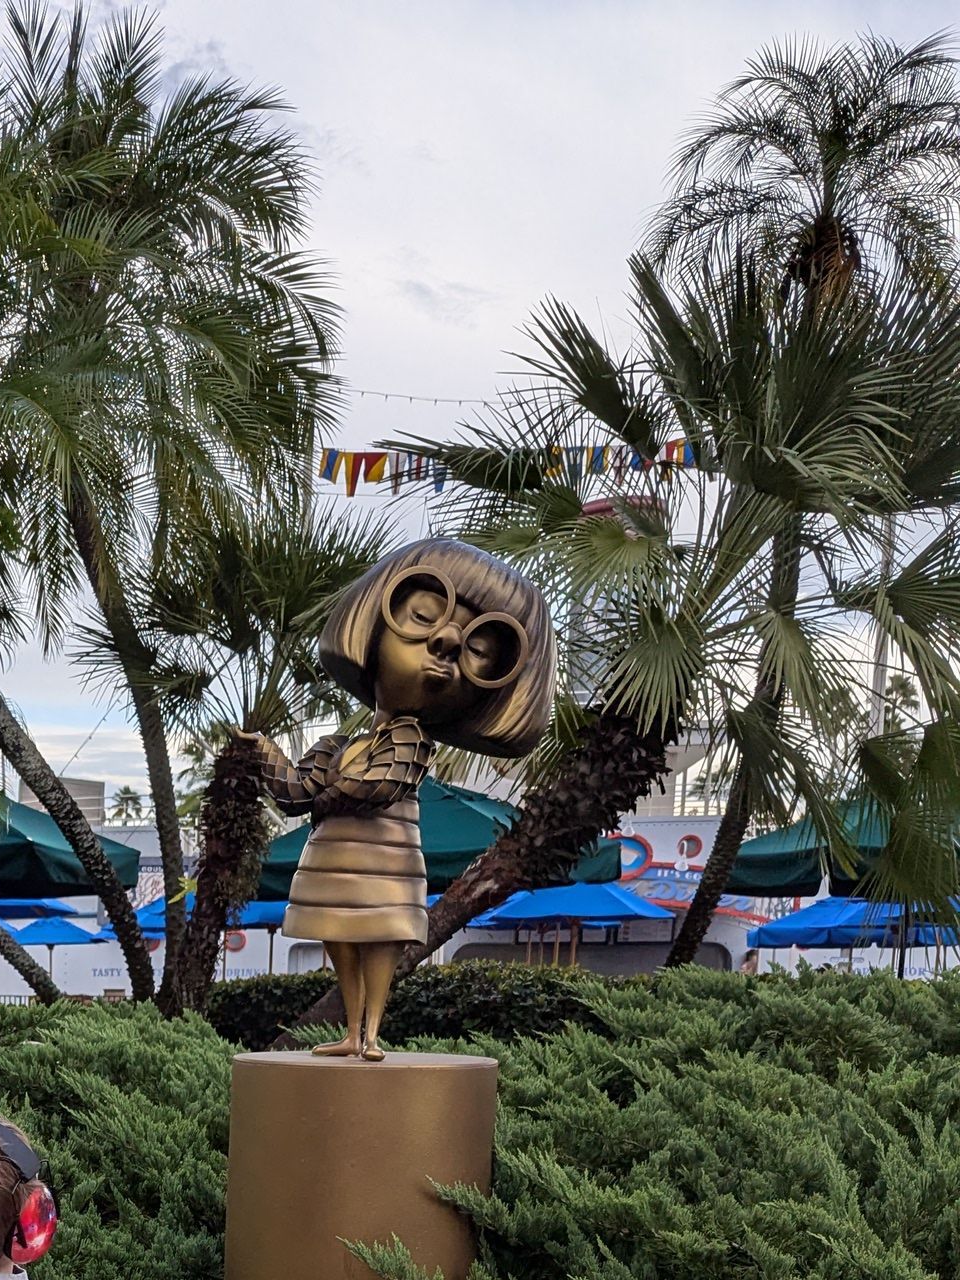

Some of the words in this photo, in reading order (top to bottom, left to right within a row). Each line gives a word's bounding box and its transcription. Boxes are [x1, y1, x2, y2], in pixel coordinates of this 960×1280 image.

[657, 868, 680, 878] IT'S
[644, 880, 754, 911] Dier
[92, 968, 122, 977] TASTY
